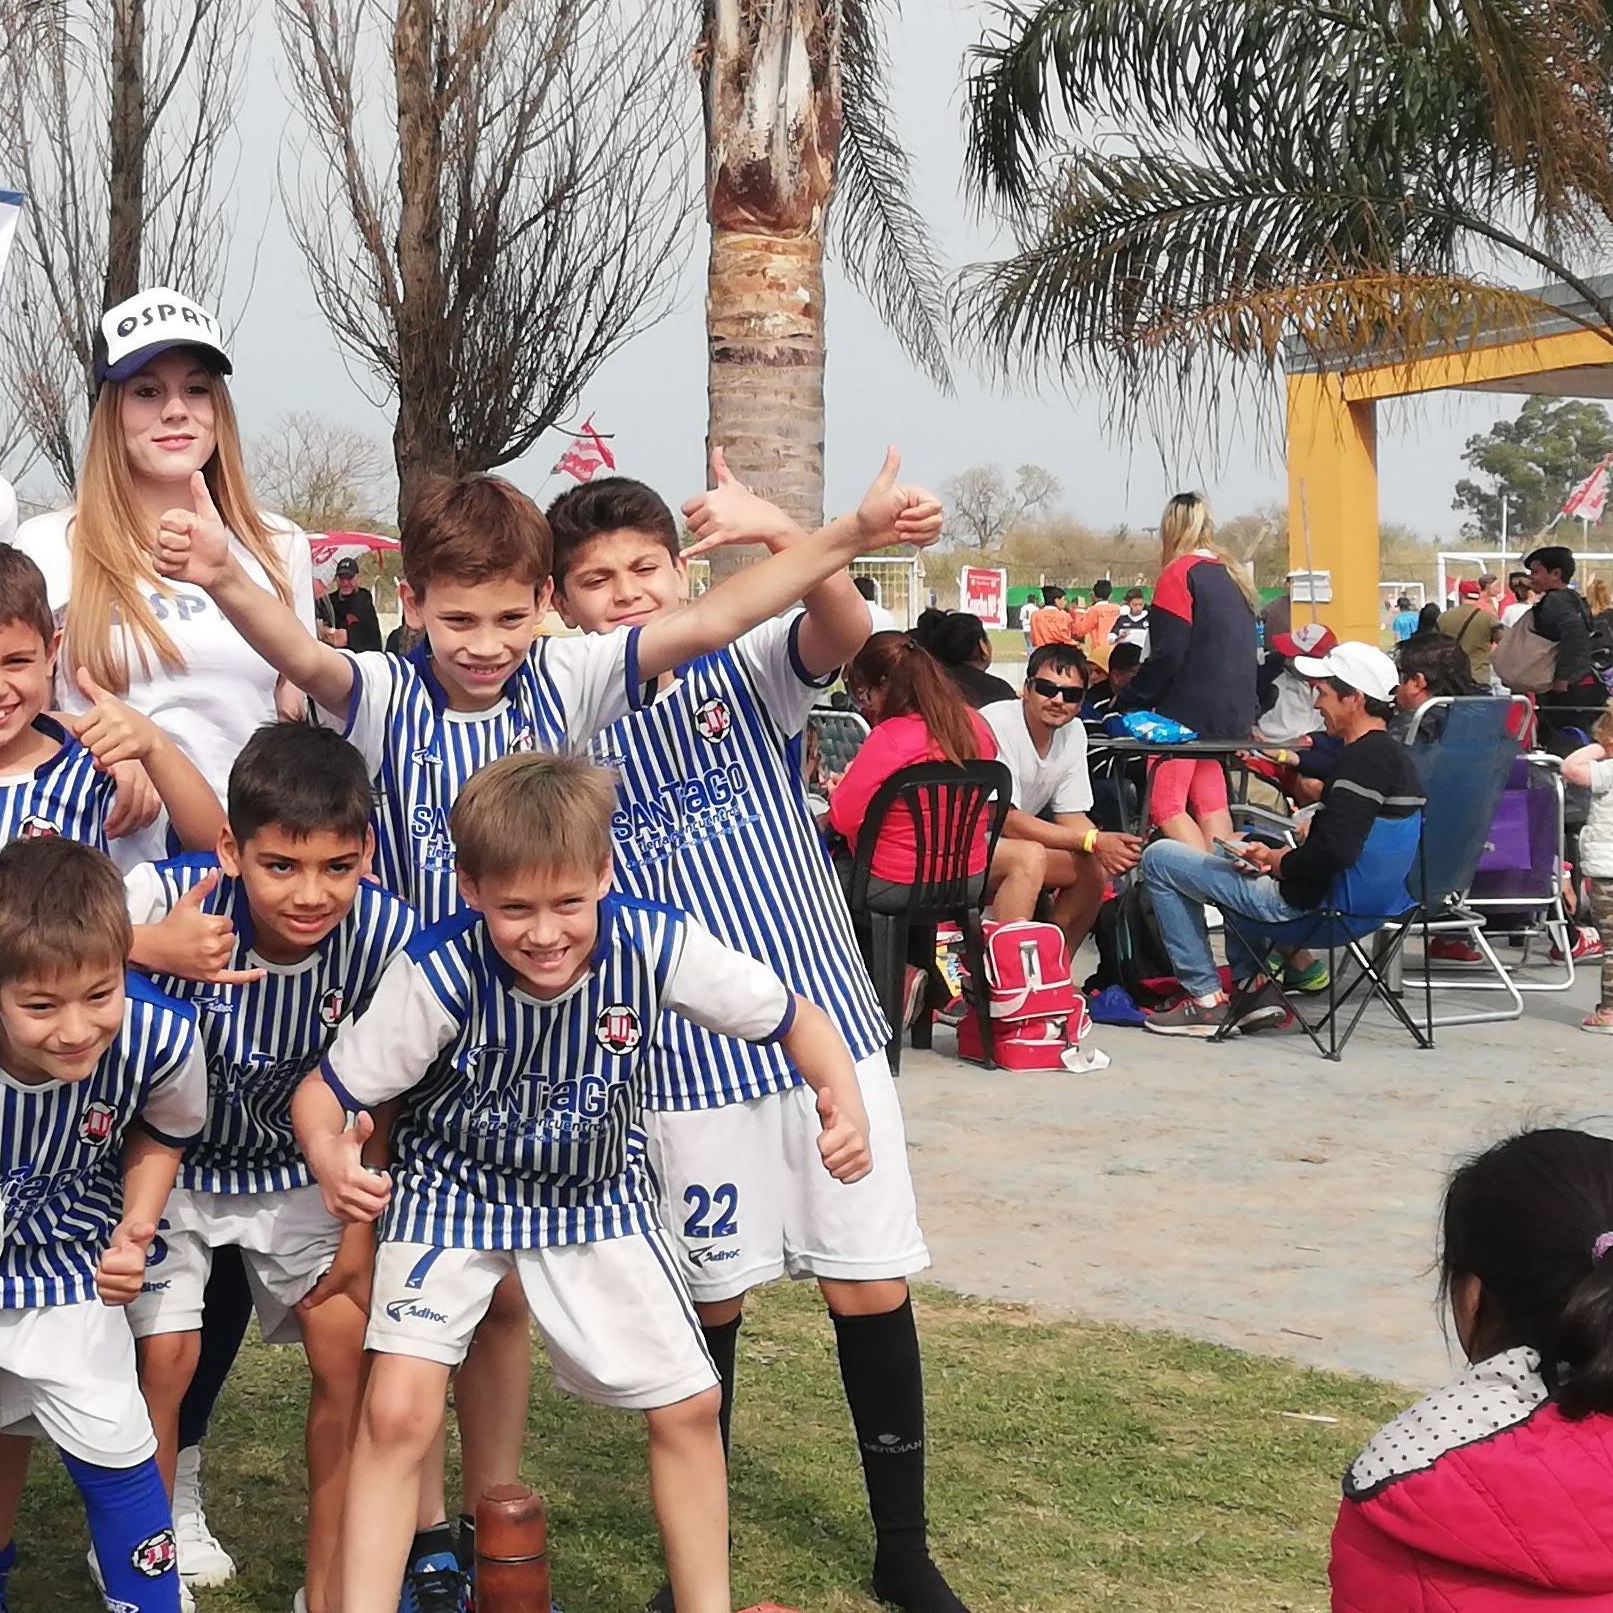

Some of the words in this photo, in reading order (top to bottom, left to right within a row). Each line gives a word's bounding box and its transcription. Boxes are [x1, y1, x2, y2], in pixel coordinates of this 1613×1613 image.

[116, 303, 213, 341] OSPAT
[683, 1182, 738, 1238] 22
[403, 1305, 449, 1324] Adhoc
